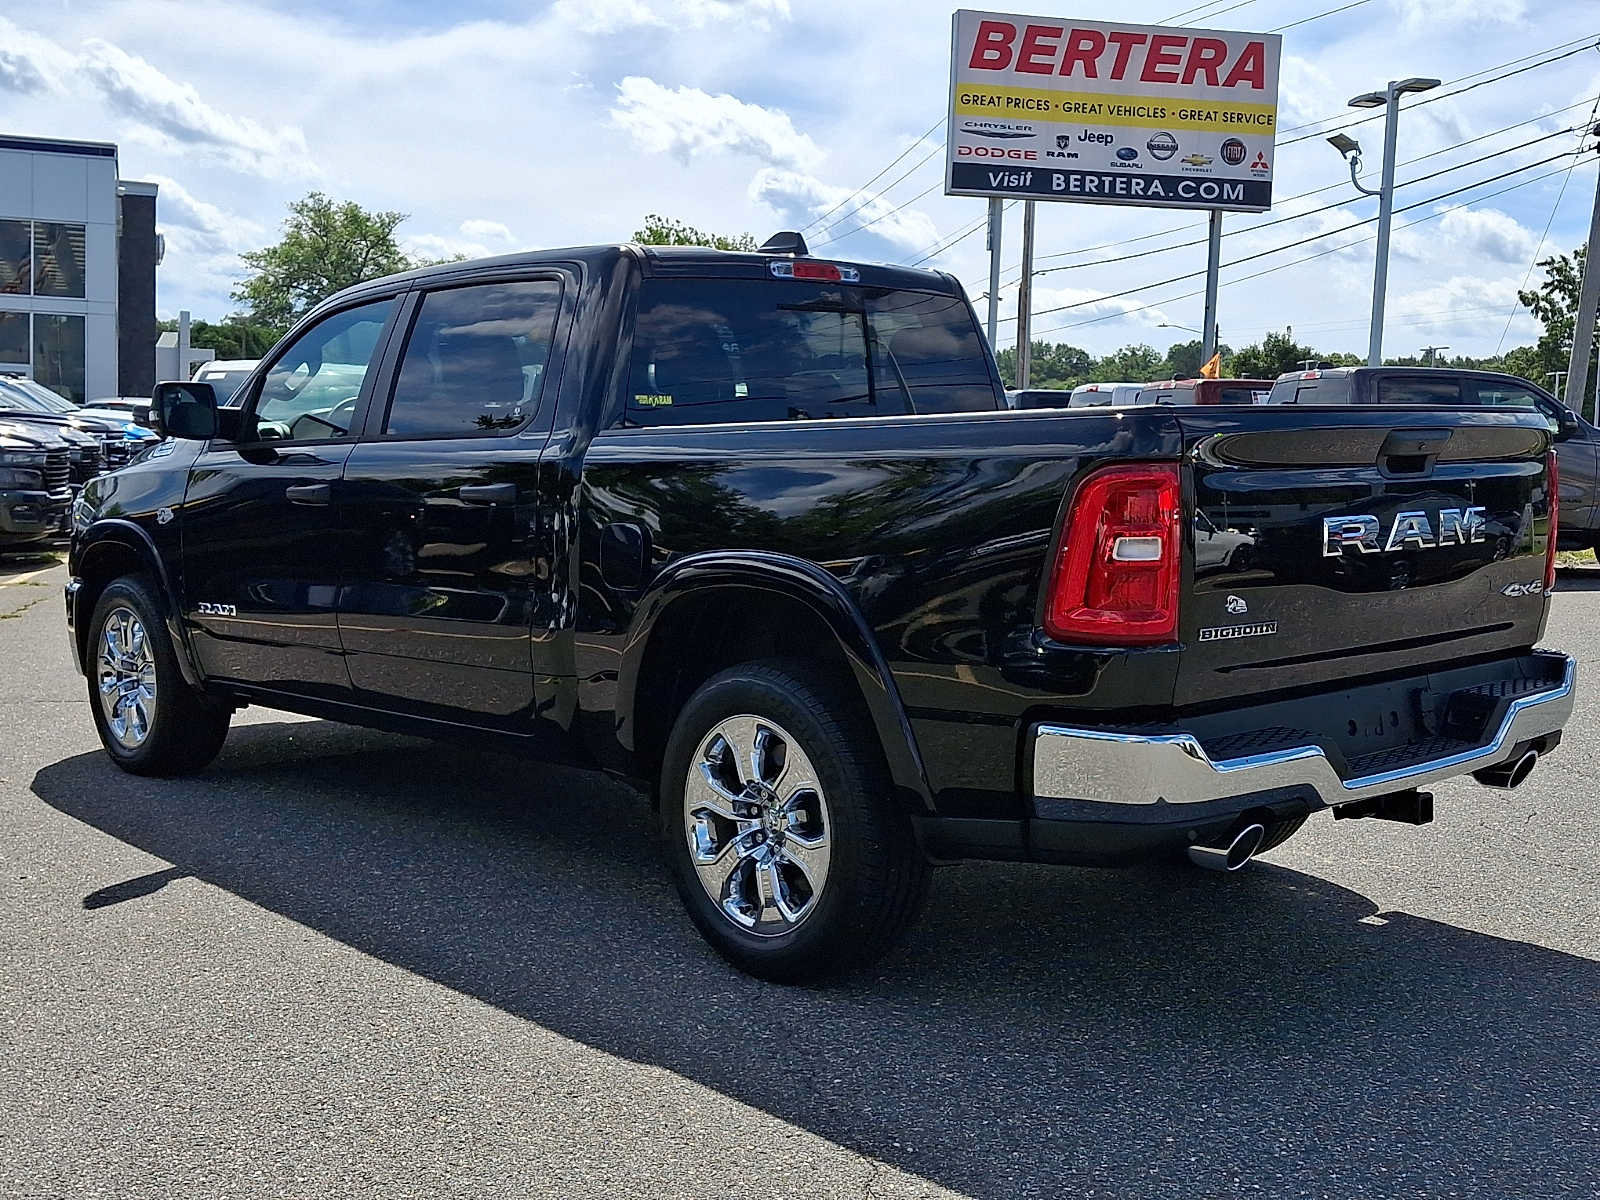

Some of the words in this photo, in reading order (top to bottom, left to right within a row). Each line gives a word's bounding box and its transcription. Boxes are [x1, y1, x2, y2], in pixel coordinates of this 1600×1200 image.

[968, 20, 1266, 89] BERTERA
[960, 93, 1002, 107] GREAT
[1006, 97, 1050, 111] PRICES
[1062, 101, 1103, 114] GREAT
[1107, 104, 1167, 119] VEHICLES
[1178, 109, 1219, 122] GREAT
[1222, 111, 1273, 125] SERVICE
[964, 121, 1033, 132] CHRYSLER
[1078, 129, 1114, 146] Jeep
[957, 145, 1038, 160] DODGE
[1046, 151, 1079, 159] RAM
[1149, 143, 1177, 151] NISSAN
[1227, 145, 1242, 159] FIAT
[1110, 161, 1143, 169] SUBARU
[988, 171, 1033, 188] Visit
[1052, 173, 1245, 201] BERTERA.COM
[1322, 506, 1486, 557] RAM
[1200, 622, 1278, 641] BIGHORN
